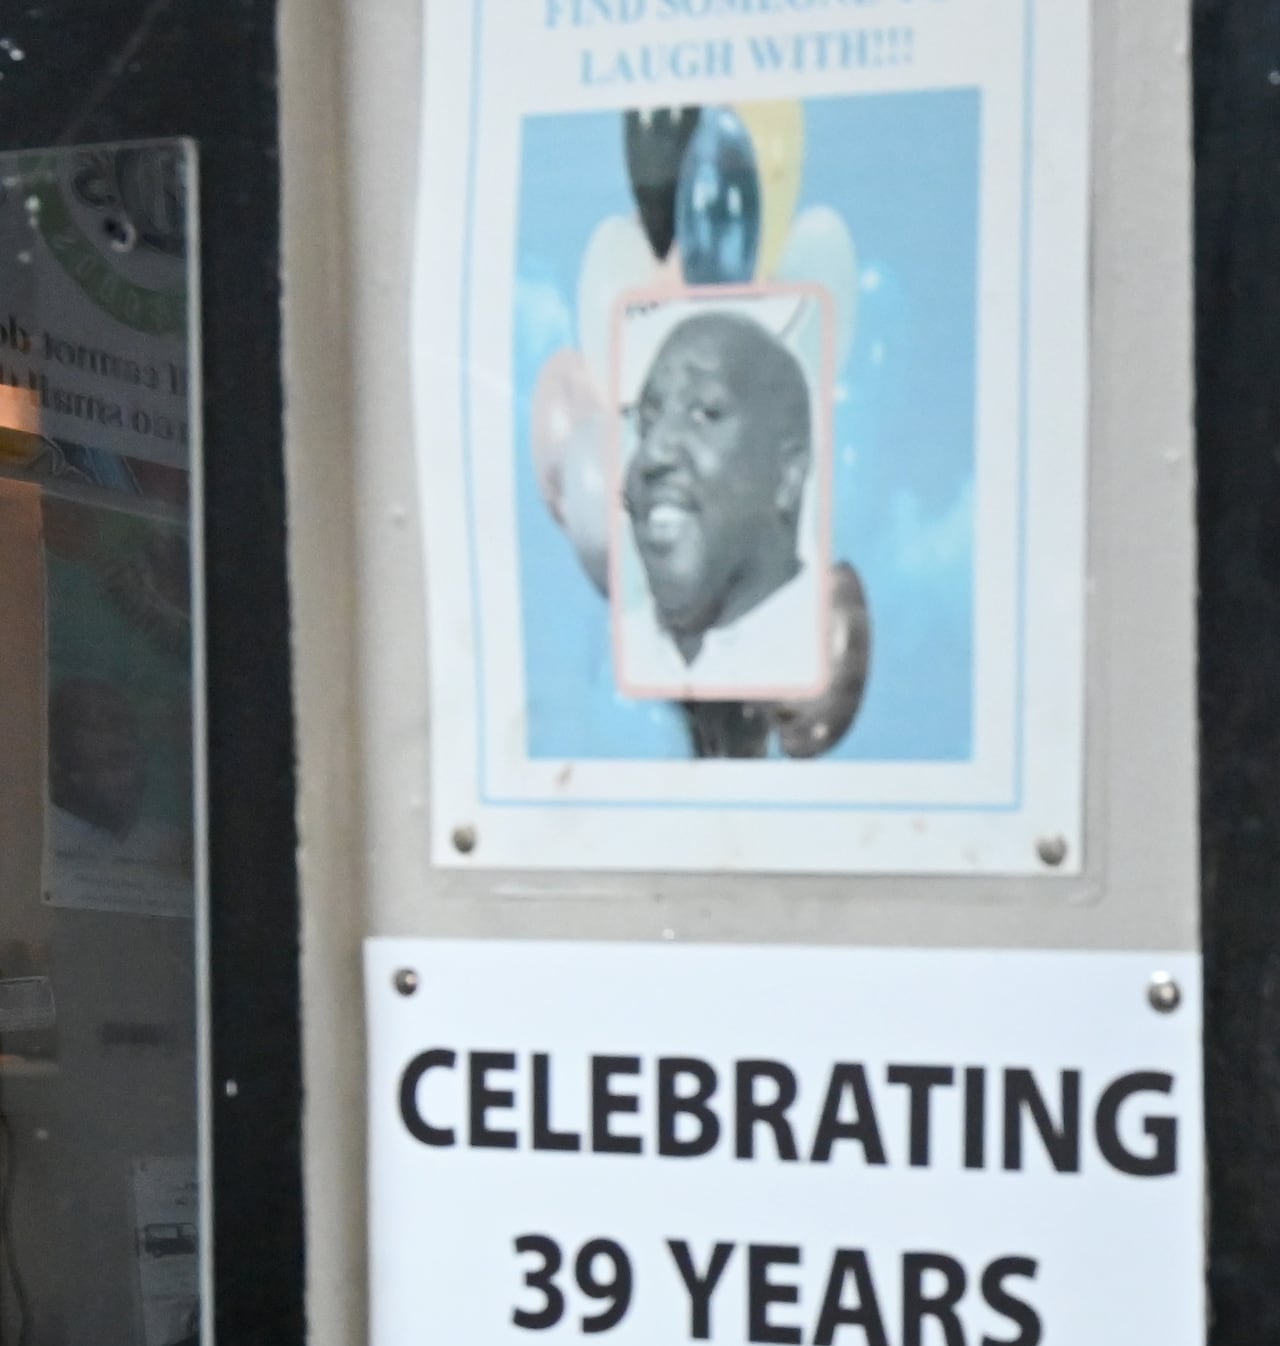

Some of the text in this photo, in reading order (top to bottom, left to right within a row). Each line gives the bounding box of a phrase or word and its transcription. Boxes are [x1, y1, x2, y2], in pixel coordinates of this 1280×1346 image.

[579, 25, 915, 85] LAUGH WITH!!!
[397, 1047, 1179, 1178] CELEBRATING
[511, 1233, 634, 1335] 39
